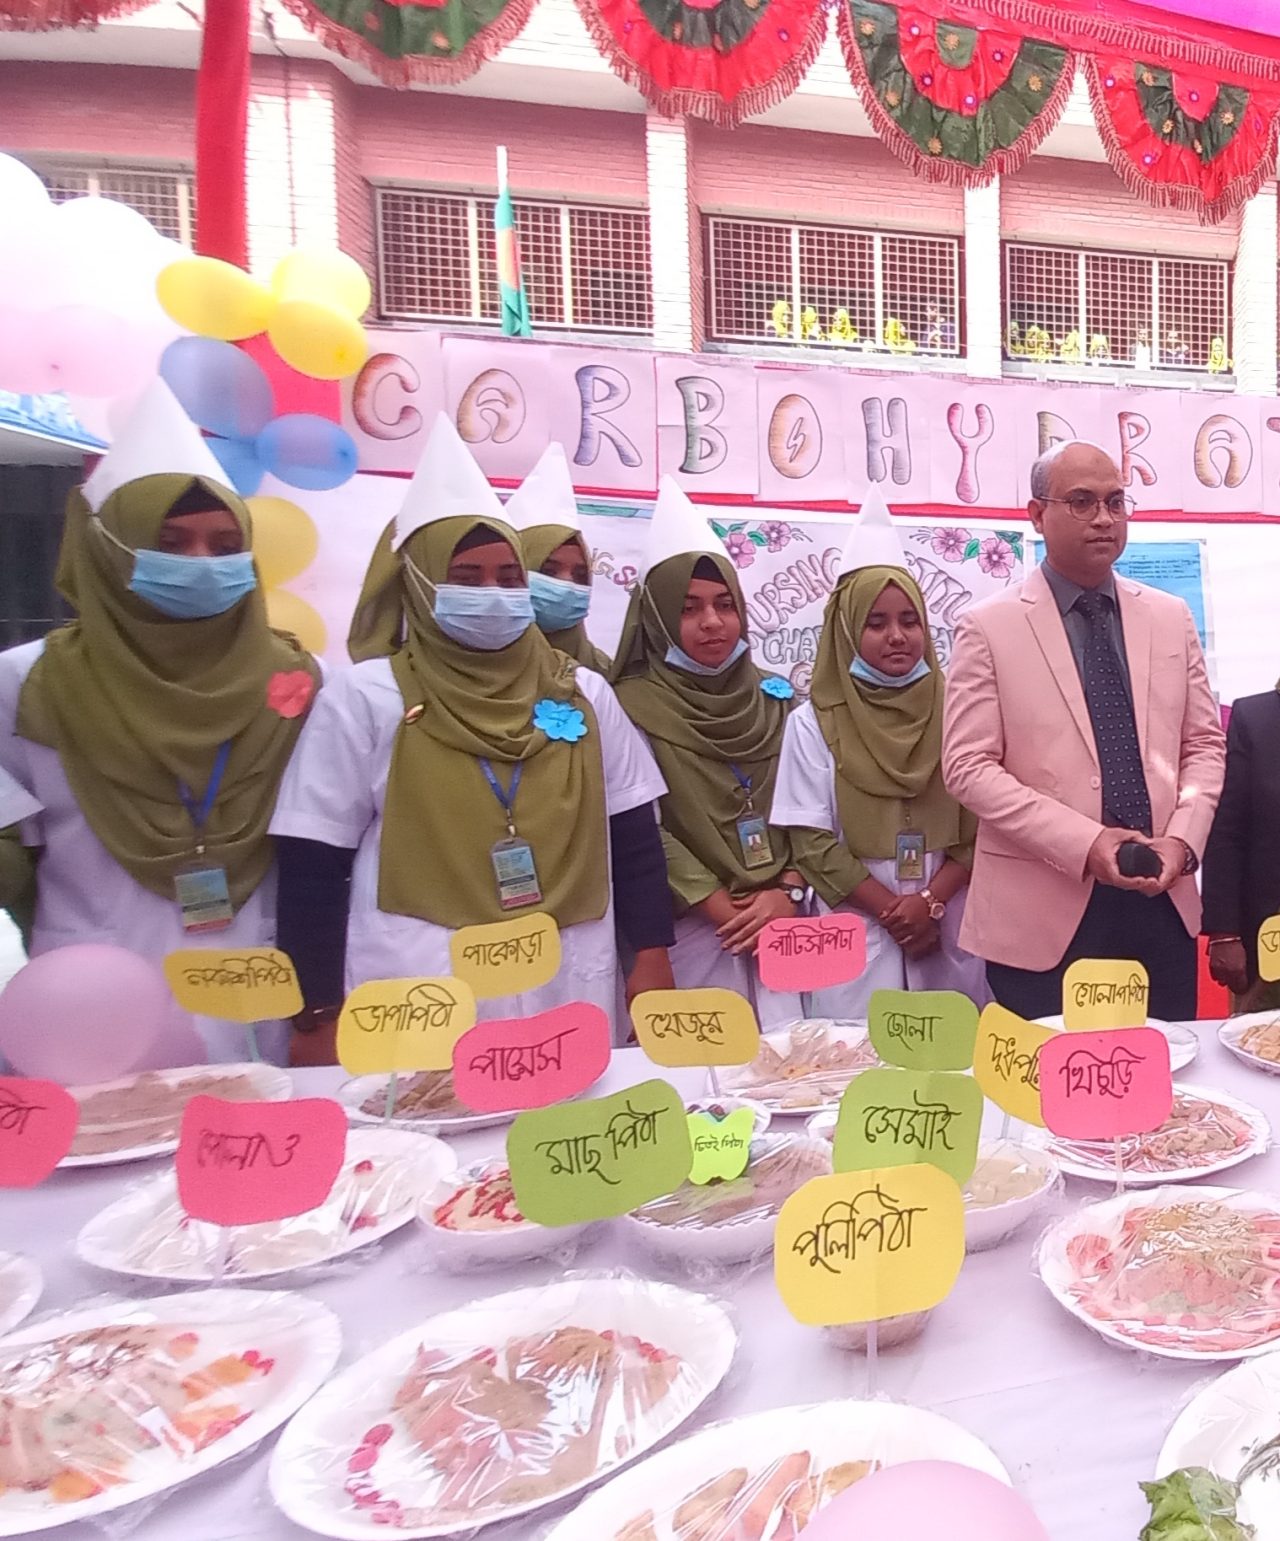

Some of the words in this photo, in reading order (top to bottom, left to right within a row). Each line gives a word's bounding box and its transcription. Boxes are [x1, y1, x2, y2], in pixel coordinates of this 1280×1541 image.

[462, 929, 547, 966] পাকোড়া
[469, 1027, 579, 1081] পায়েস
[646, 1011, 726, 1046] খেজুর
[883, 1011, 943, 1051] ছোলা
[1059, 1046, 1146, 1099] খিচুড়ি
[535, 1134, 622, 1185] মাছ
[604, 1100, 669, 1160] পিঠা
[862, 1089, 962, 1151] সেমাই
[792, 1184, 928, 1273] পুলিপিঠা
